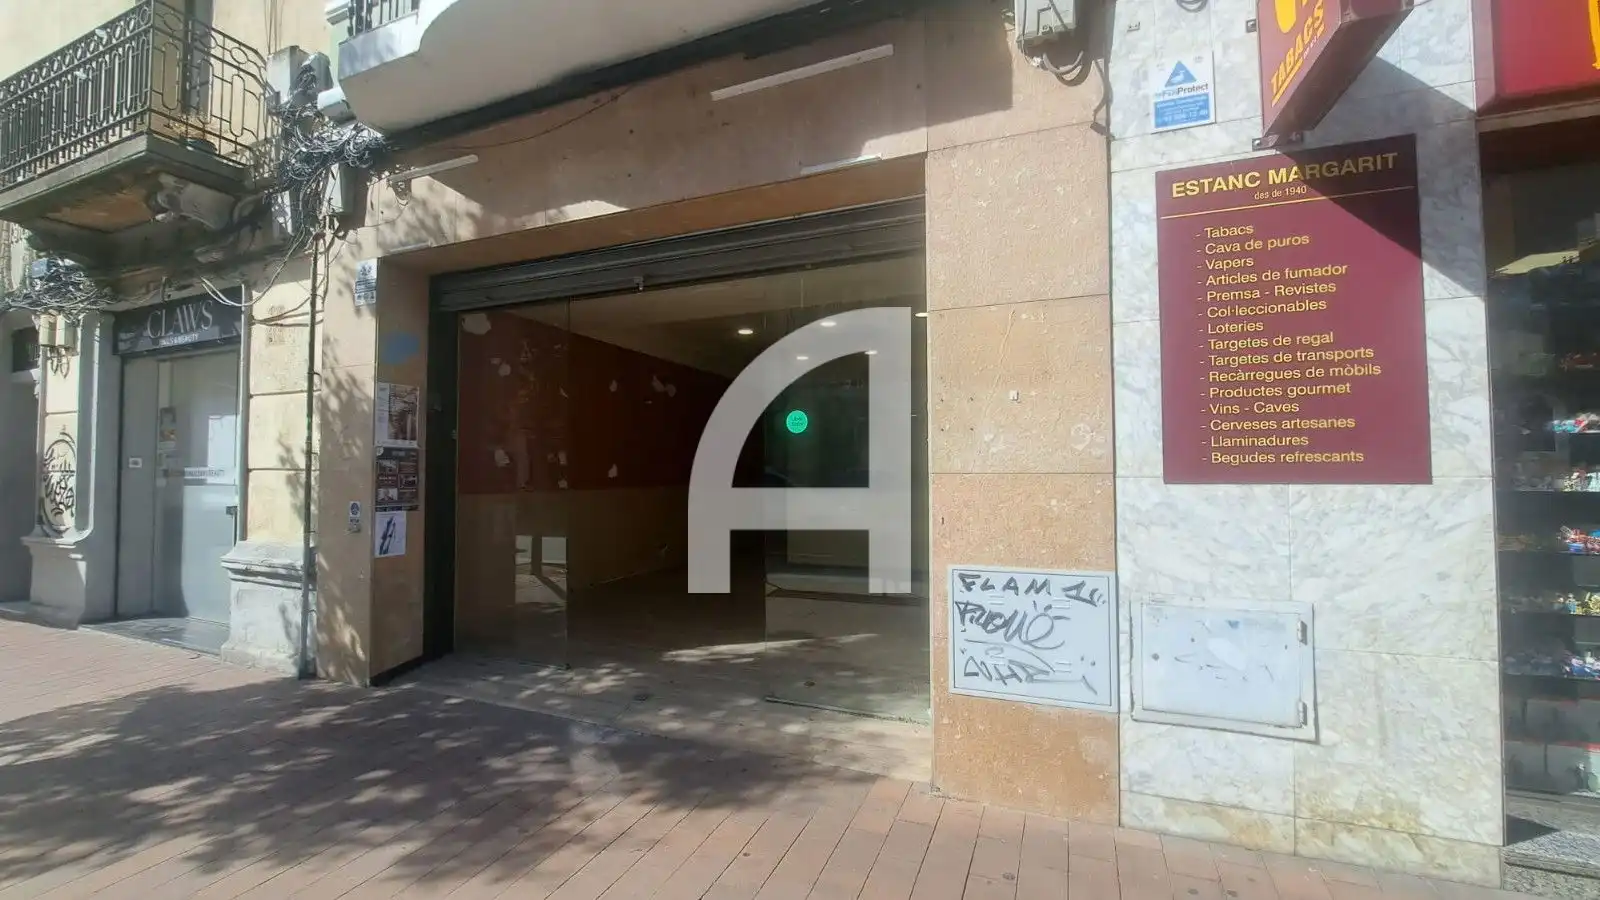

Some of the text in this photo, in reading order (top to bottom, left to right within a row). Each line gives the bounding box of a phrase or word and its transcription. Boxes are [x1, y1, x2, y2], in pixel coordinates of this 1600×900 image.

[1271, 0, 1324, 95] TABACS
[1172, 152, 1398, 198] ESTANC MARGARIT
[1254, 185, 1307, 200] des de 1940
[1204, 225, 1254, 239] Tabacs
[1205, 235, 1310, 255] Cava de puros
[1206, 257, 1254, 273] Vapers
[1206, 264, 1348, 287] Articles de fumador
[1207, 287, 1261, 302] Premsa
[1274, 282, 1337, 297] Revistes
[147, 300, 213, 339] CLAWS
[1208, 321, 1264, 334] Loteries
[1208, 331, 1334, 352] Targetes de regal
[1209, 346, 1374, 368] Targetes de transports
[1209, 363, 1382, 385] Recàrregues de mòbils
[1210, 382, 1351, 399] Productes gourmet
[1210, 403, 1240, 415] Vins
[1254, 400, 1300, 414] Caves
[1210, 415, 1356, 431] Cerveses artesanes
[1211, 433, 1309, 448] Llaminadures
[1211, 449, 1364, 466] Begudes refrescants
